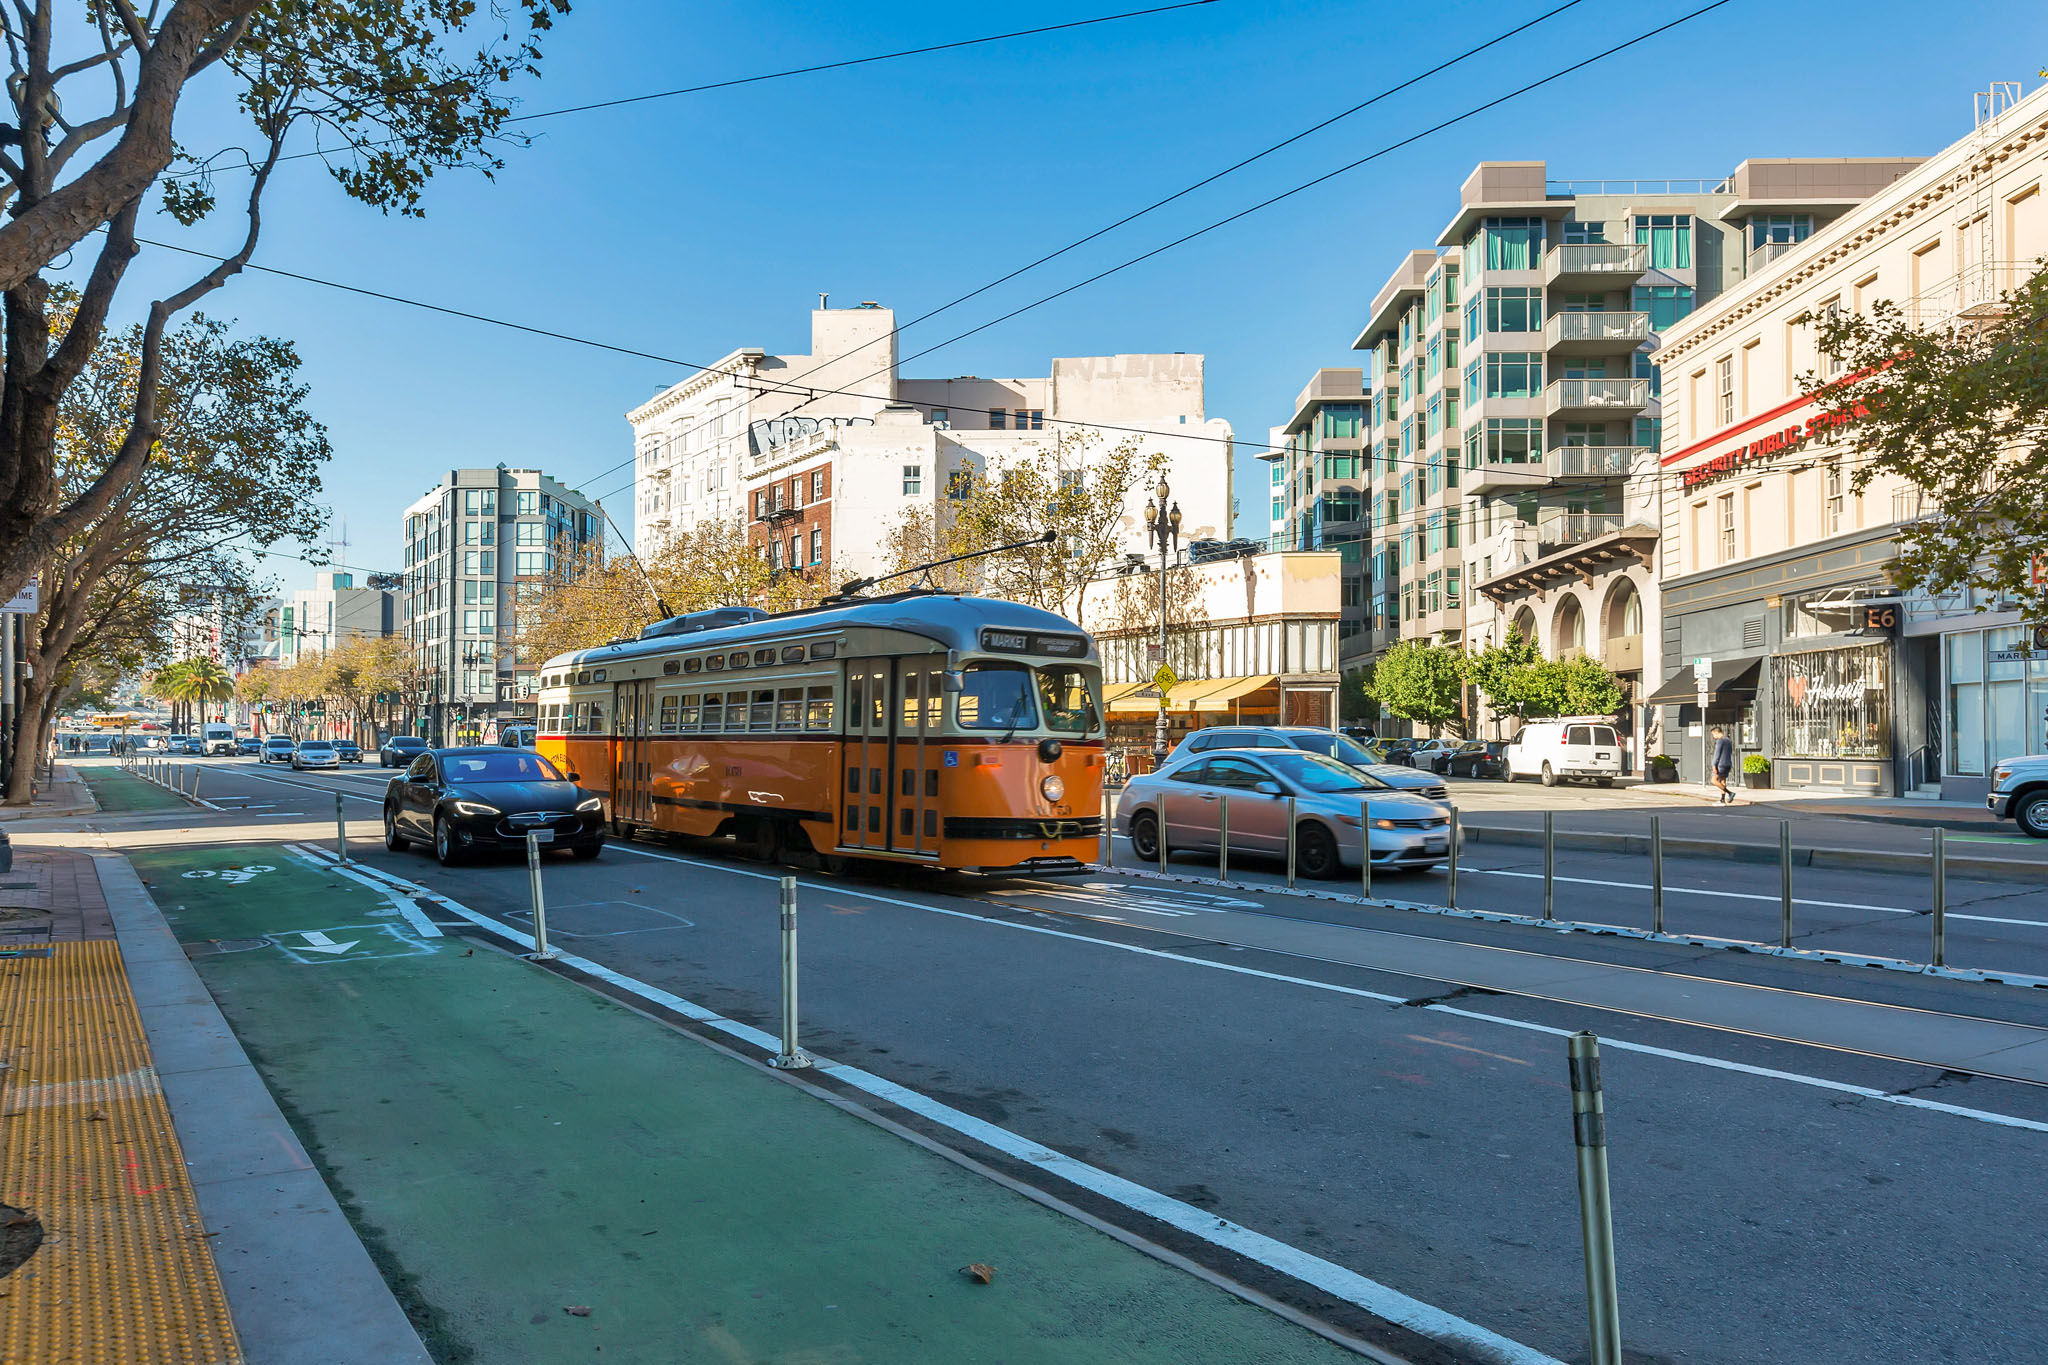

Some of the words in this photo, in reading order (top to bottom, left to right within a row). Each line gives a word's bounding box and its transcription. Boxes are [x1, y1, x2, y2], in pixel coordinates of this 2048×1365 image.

[1685, 446, 1745, 486] SECURITY
[1749, 424, 1799, 459] PUBLIC
[1868, 608, 1895, 628] E6
[982, 632, 989, 646] F
[991, 632, 1028, 649] MARKET
[1997, 651, 2040, 660] MART
